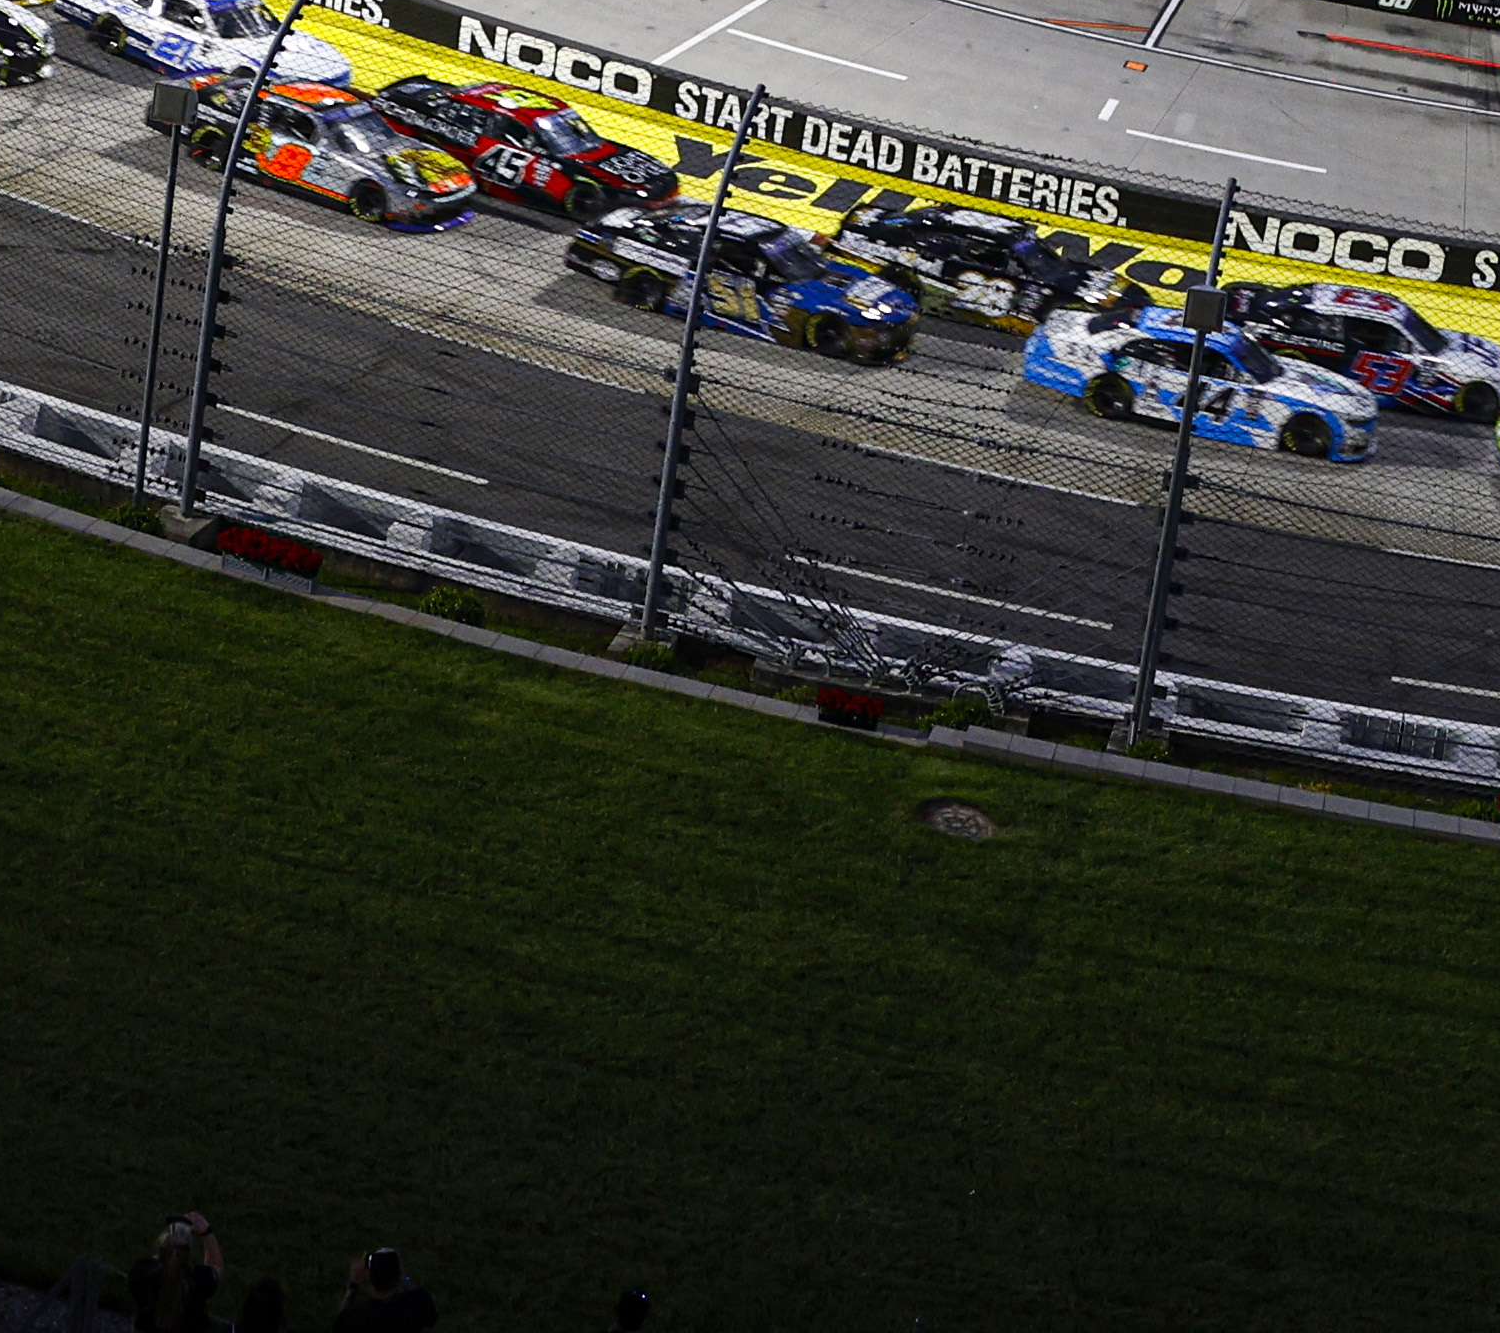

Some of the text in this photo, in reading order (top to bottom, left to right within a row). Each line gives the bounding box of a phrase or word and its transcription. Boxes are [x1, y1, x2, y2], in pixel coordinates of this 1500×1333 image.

[154, 33, 198, 67] 21
[458, 14, 654, 108] NOCO
[476, 146, 526, 187] 45
[674, 81, 1128, 228] START DEAD BATTERIES.
[1223, 210, 1446, 283] NOCO
[1348, 351, 1414, 393] 53
